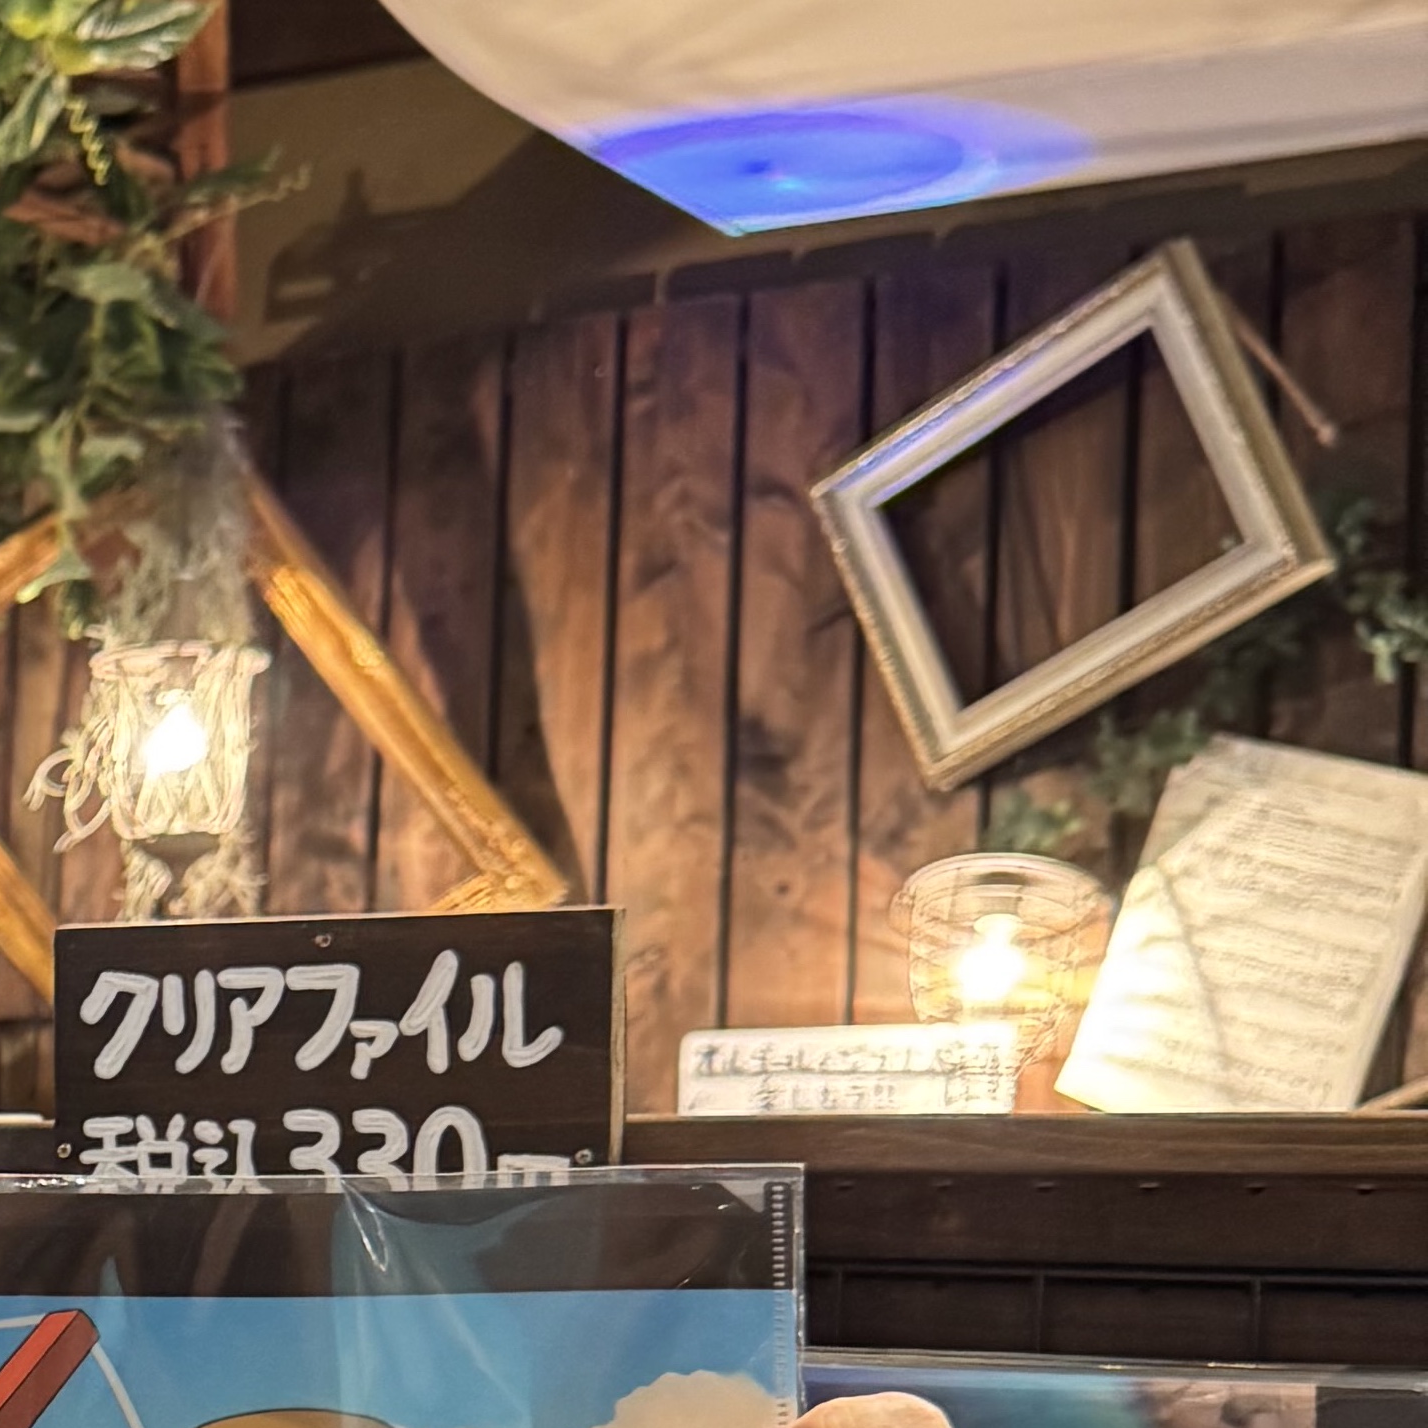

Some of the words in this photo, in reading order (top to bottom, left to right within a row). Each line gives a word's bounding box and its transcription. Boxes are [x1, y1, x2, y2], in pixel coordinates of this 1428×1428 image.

[79, 949, 564, 1080] クリアファイル
